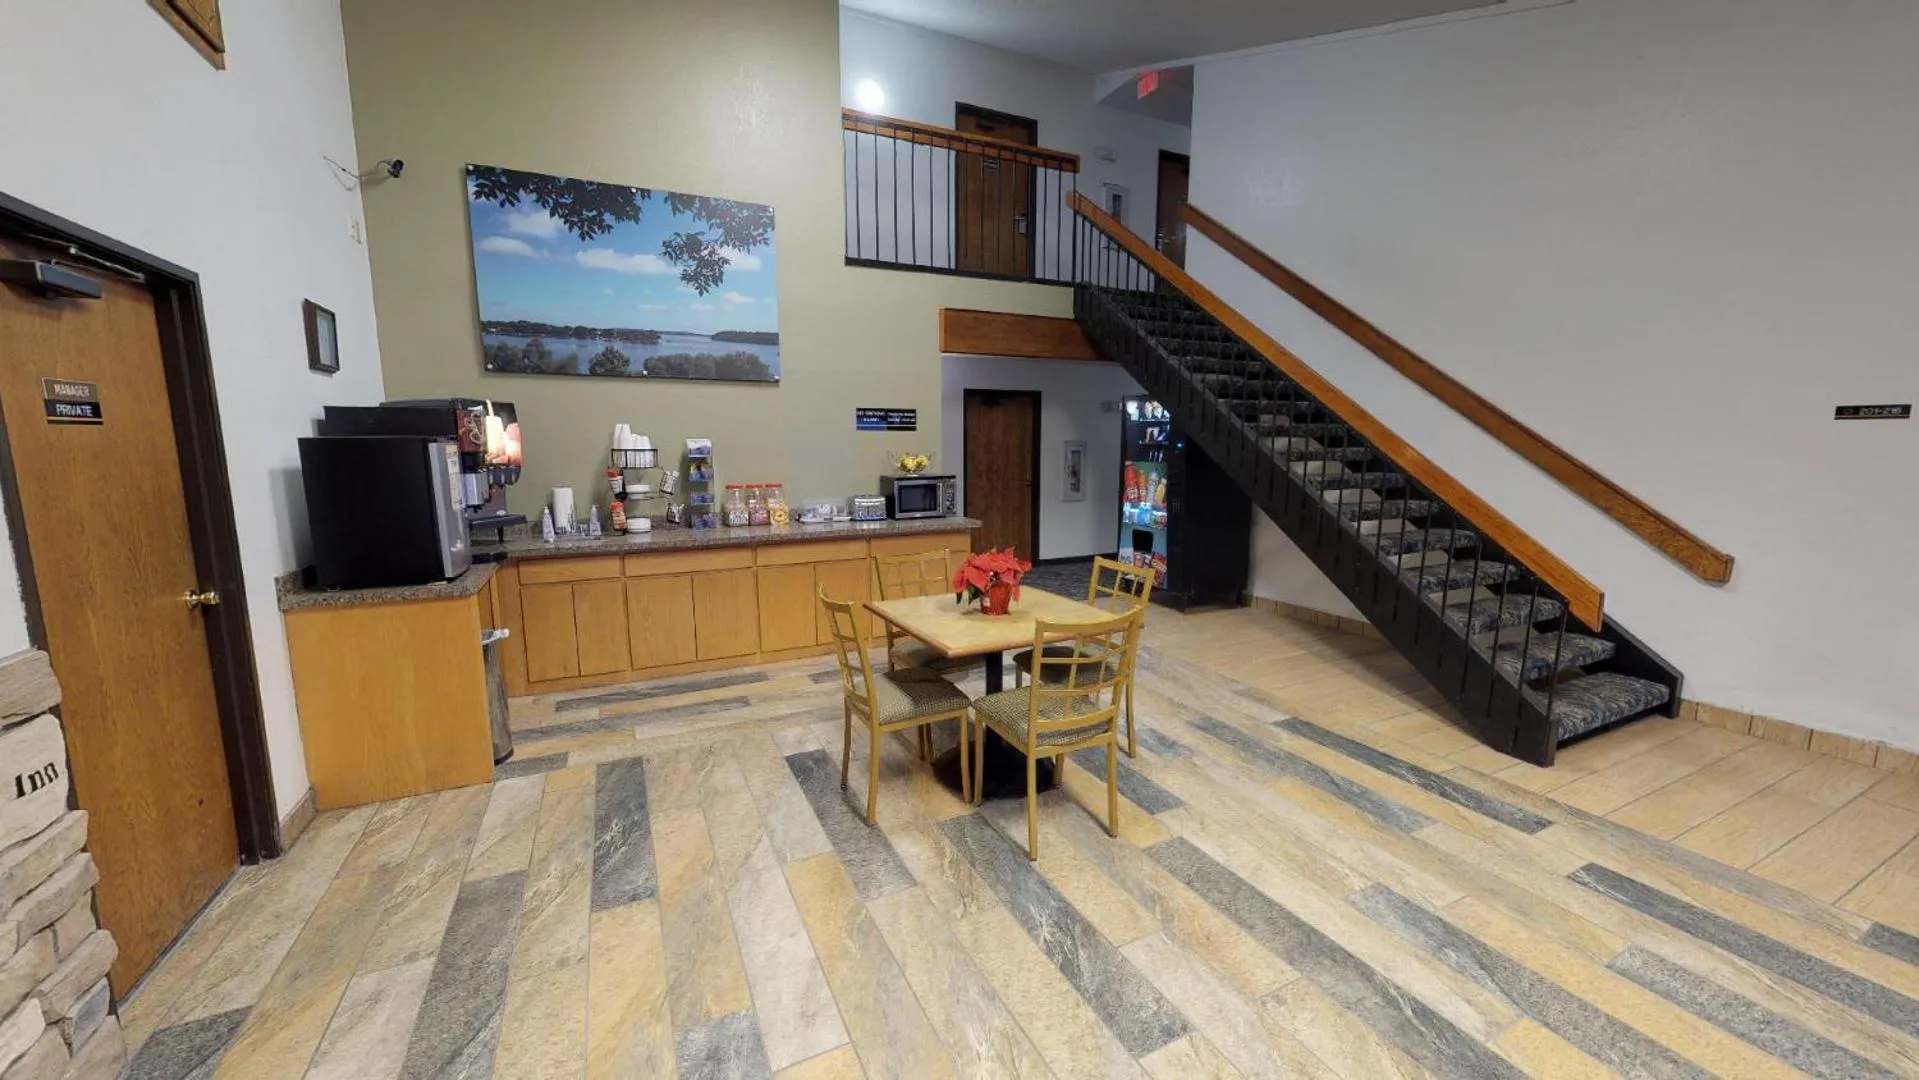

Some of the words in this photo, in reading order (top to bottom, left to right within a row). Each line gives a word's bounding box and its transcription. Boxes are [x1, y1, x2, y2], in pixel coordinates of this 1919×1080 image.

[53, 383, 90, 397] MANAGER
[55, 404, 93, 417] PRIVATE
[15, 761, 59, 799] Inn
